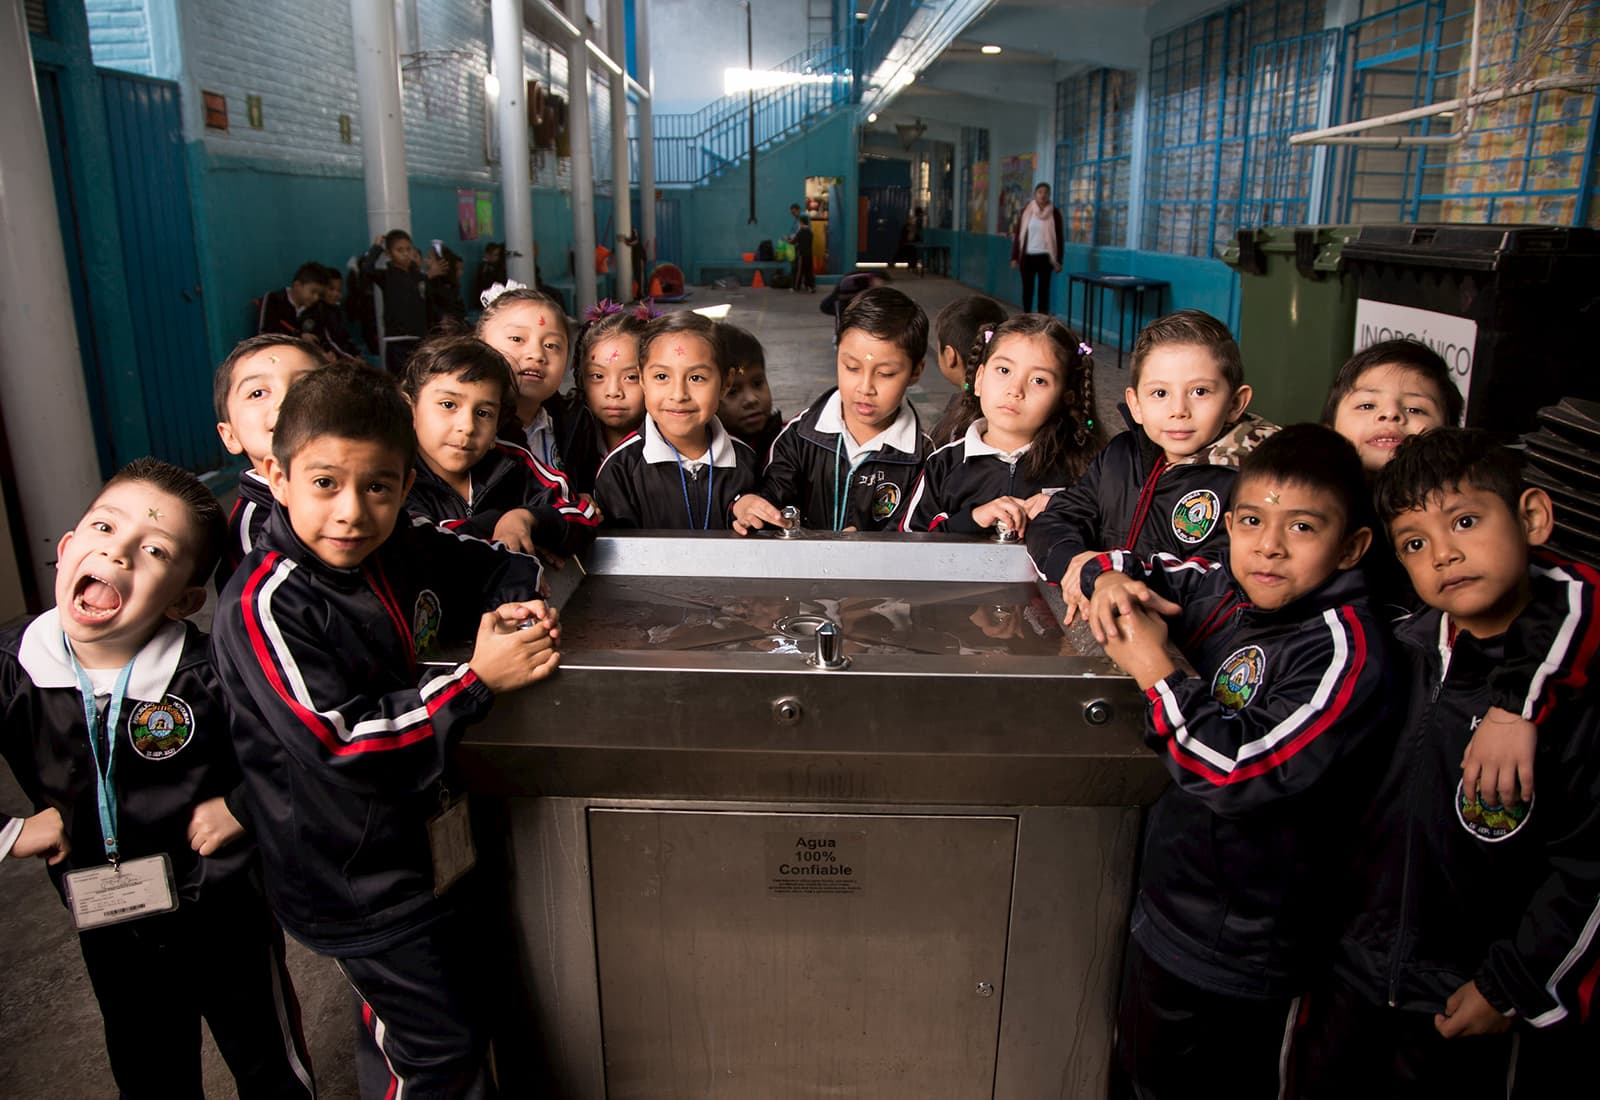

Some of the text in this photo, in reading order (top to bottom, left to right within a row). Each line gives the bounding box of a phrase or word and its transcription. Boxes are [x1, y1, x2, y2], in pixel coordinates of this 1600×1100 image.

[796, 837, 836, 850] Agua
[795, 851, 836, 863] 100%
[779, 864, 852, 876] Confiable
